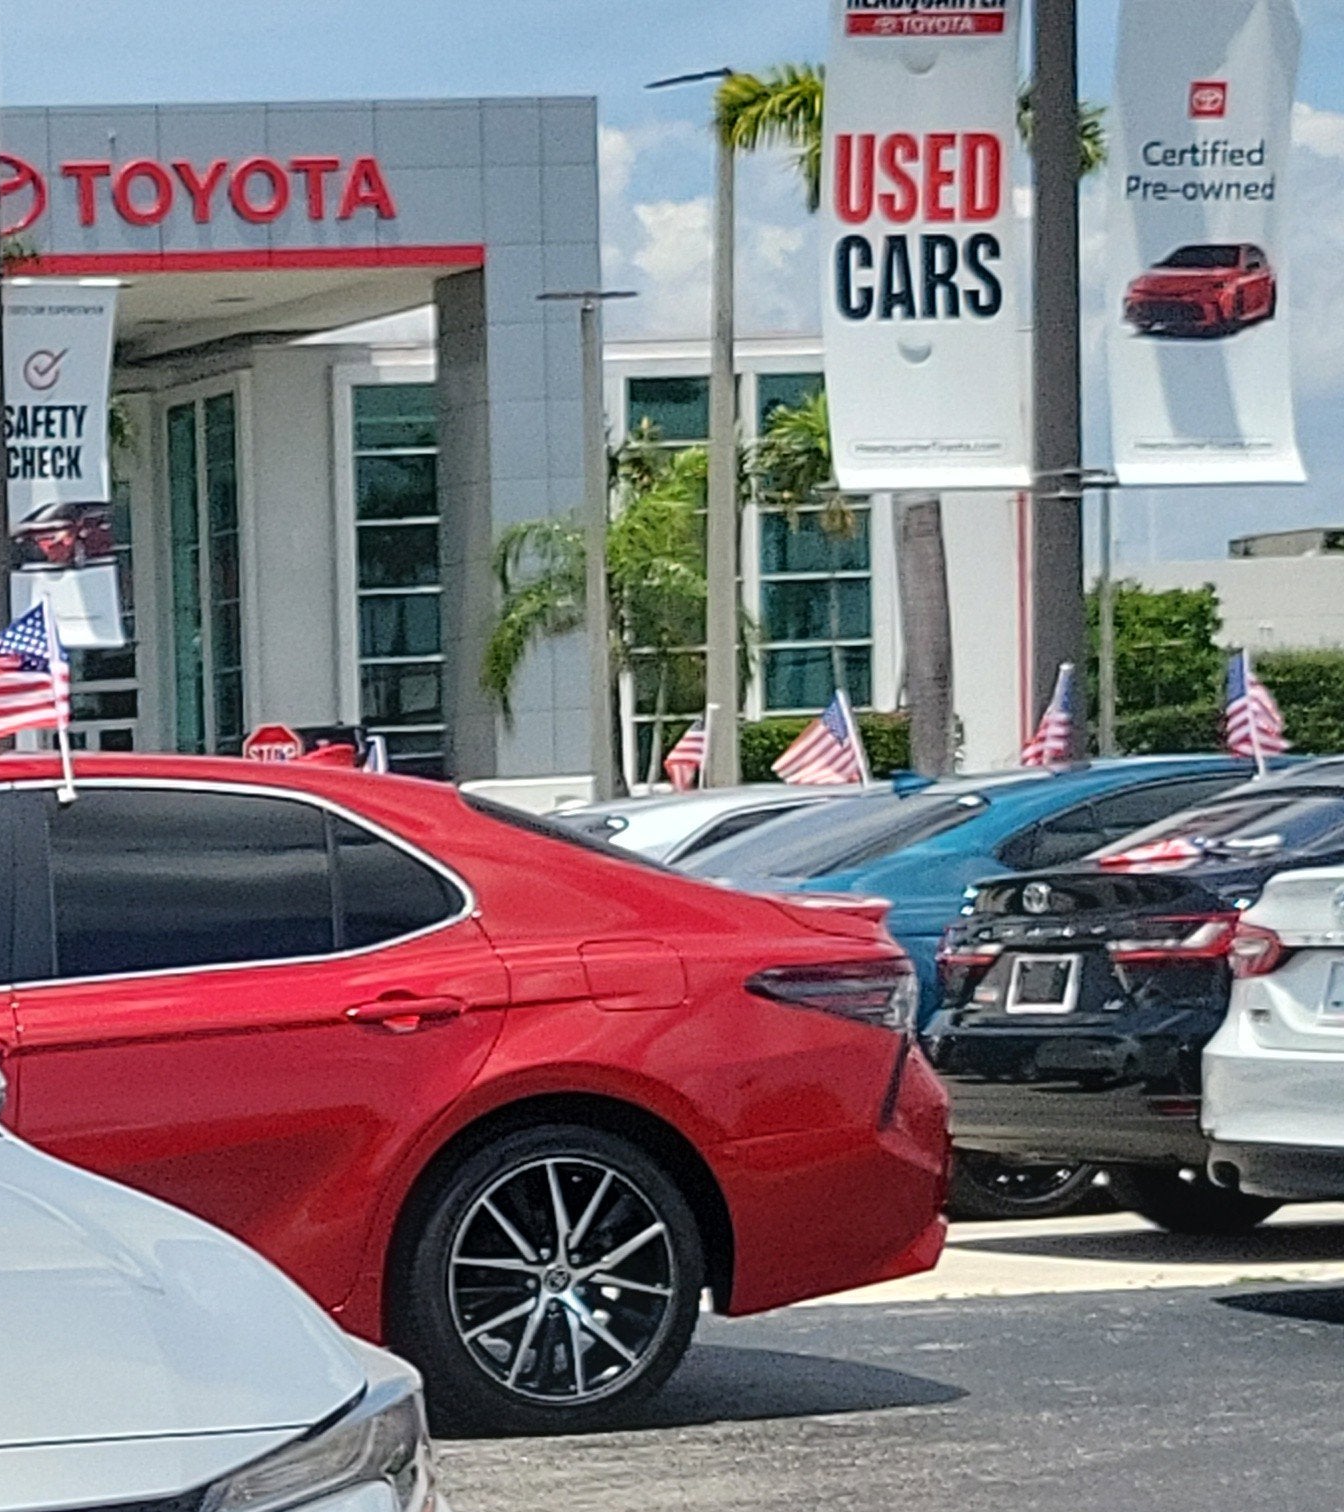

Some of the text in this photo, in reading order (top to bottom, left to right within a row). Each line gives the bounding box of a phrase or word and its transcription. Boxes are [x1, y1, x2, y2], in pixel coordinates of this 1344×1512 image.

[902, 15, 975, 34] TOYOTA
[1142, 138, 1265, 167] Certified
[60, 155, 396, 227] TOYOTA
[834, 132, 1002, 225] USED
[1125, 172, 1276, 201] Pre-owned
[835, 232, 1003, 321] CARS
[3, 404, 88, 439] SAFETY
[6, 444, 83, 480] CHECK
